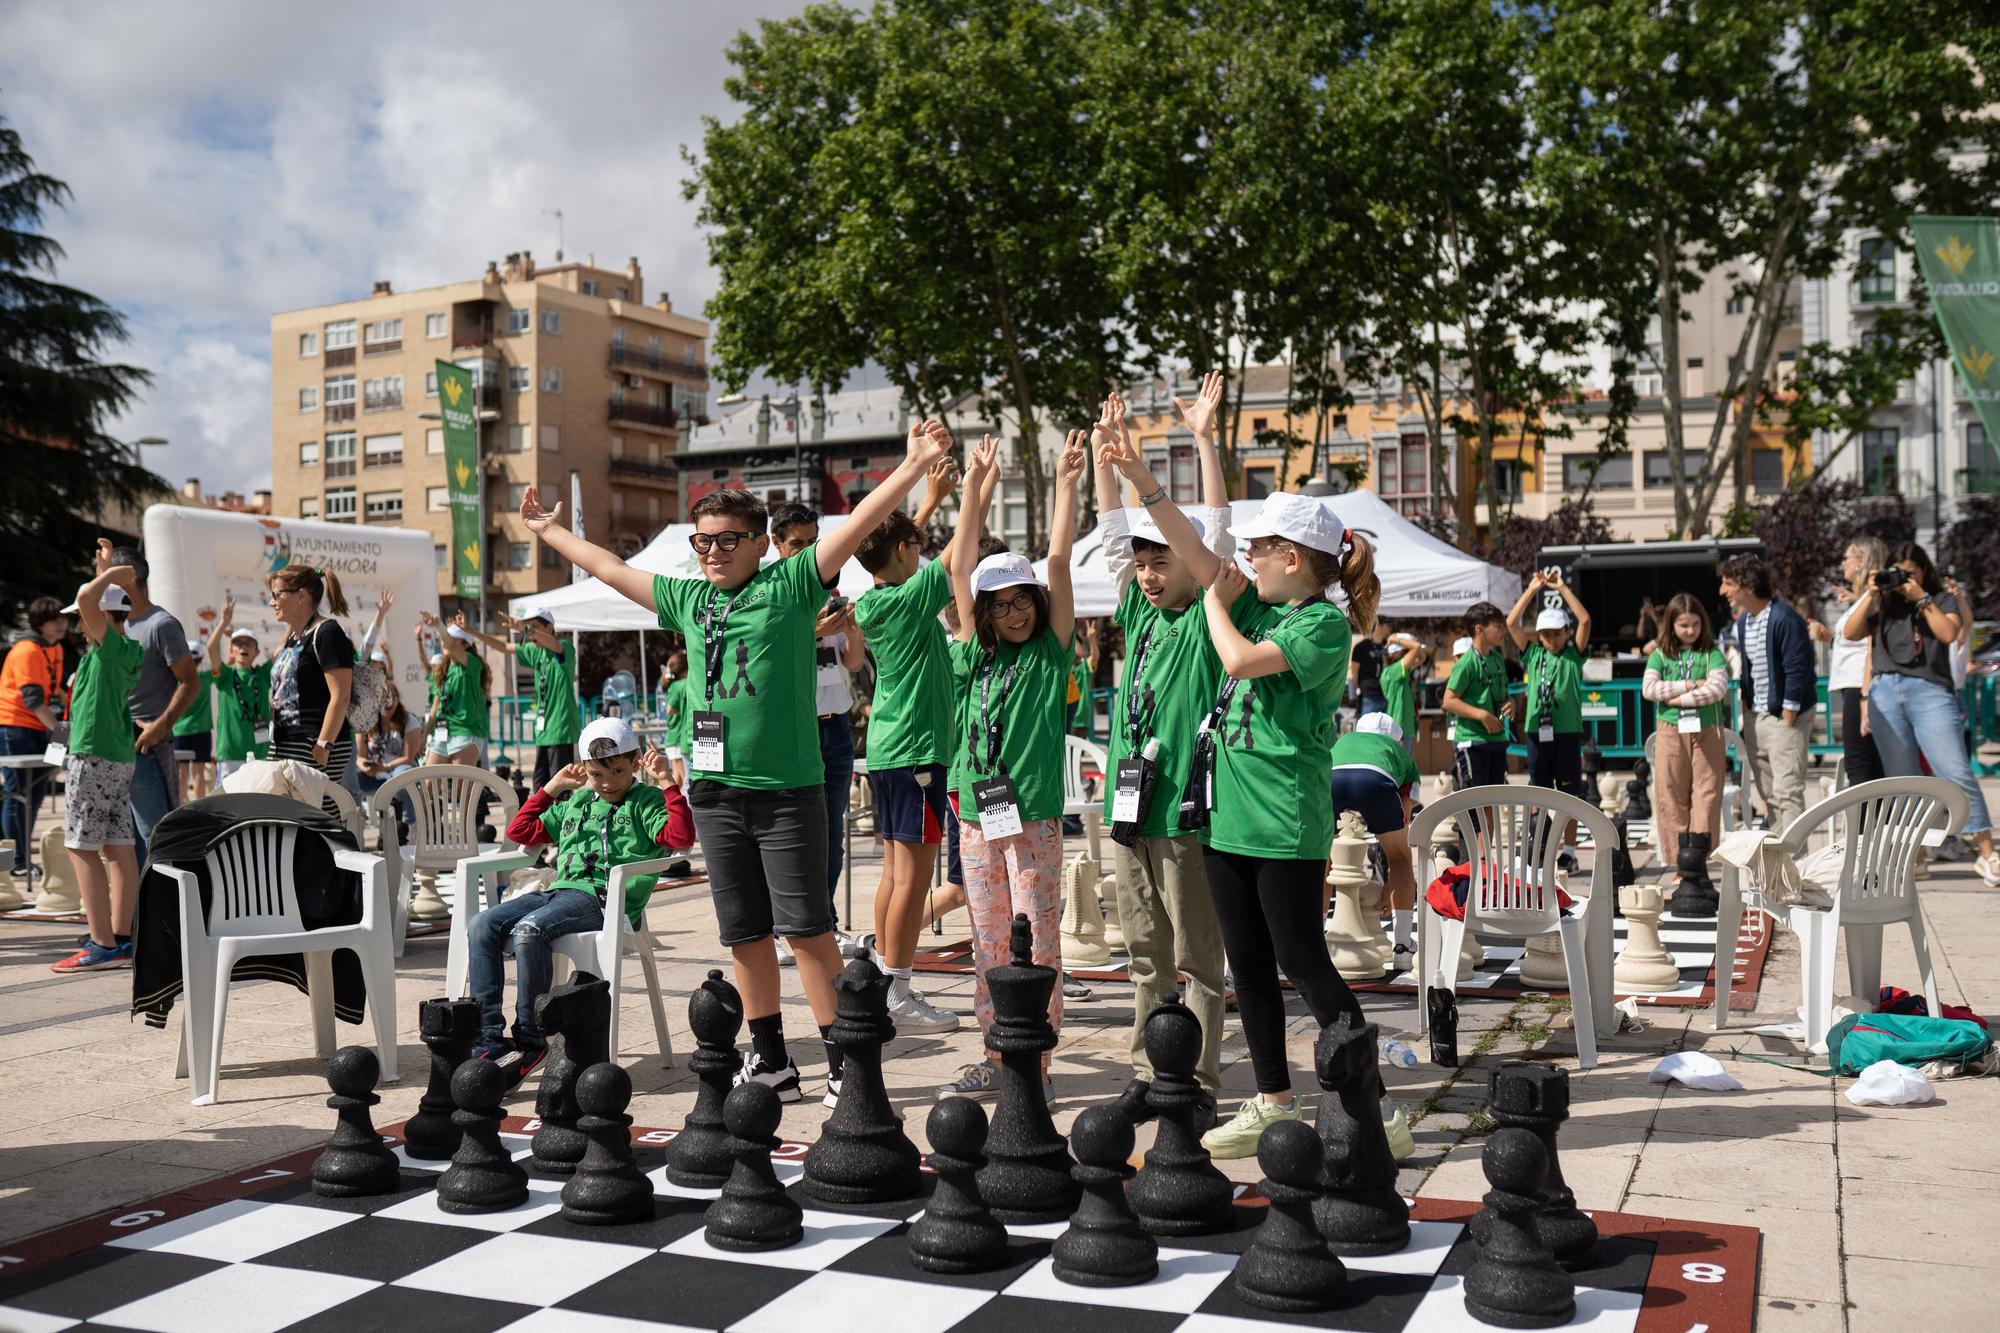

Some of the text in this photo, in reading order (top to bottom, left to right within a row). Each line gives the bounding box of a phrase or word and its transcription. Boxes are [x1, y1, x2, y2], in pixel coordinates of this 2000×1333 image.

[296, 536, 382, 556] AYUNTAMIENTO
[317, 554, 377, 574] ZAMORA
[1681, 1262, 1727, 1283] 8
